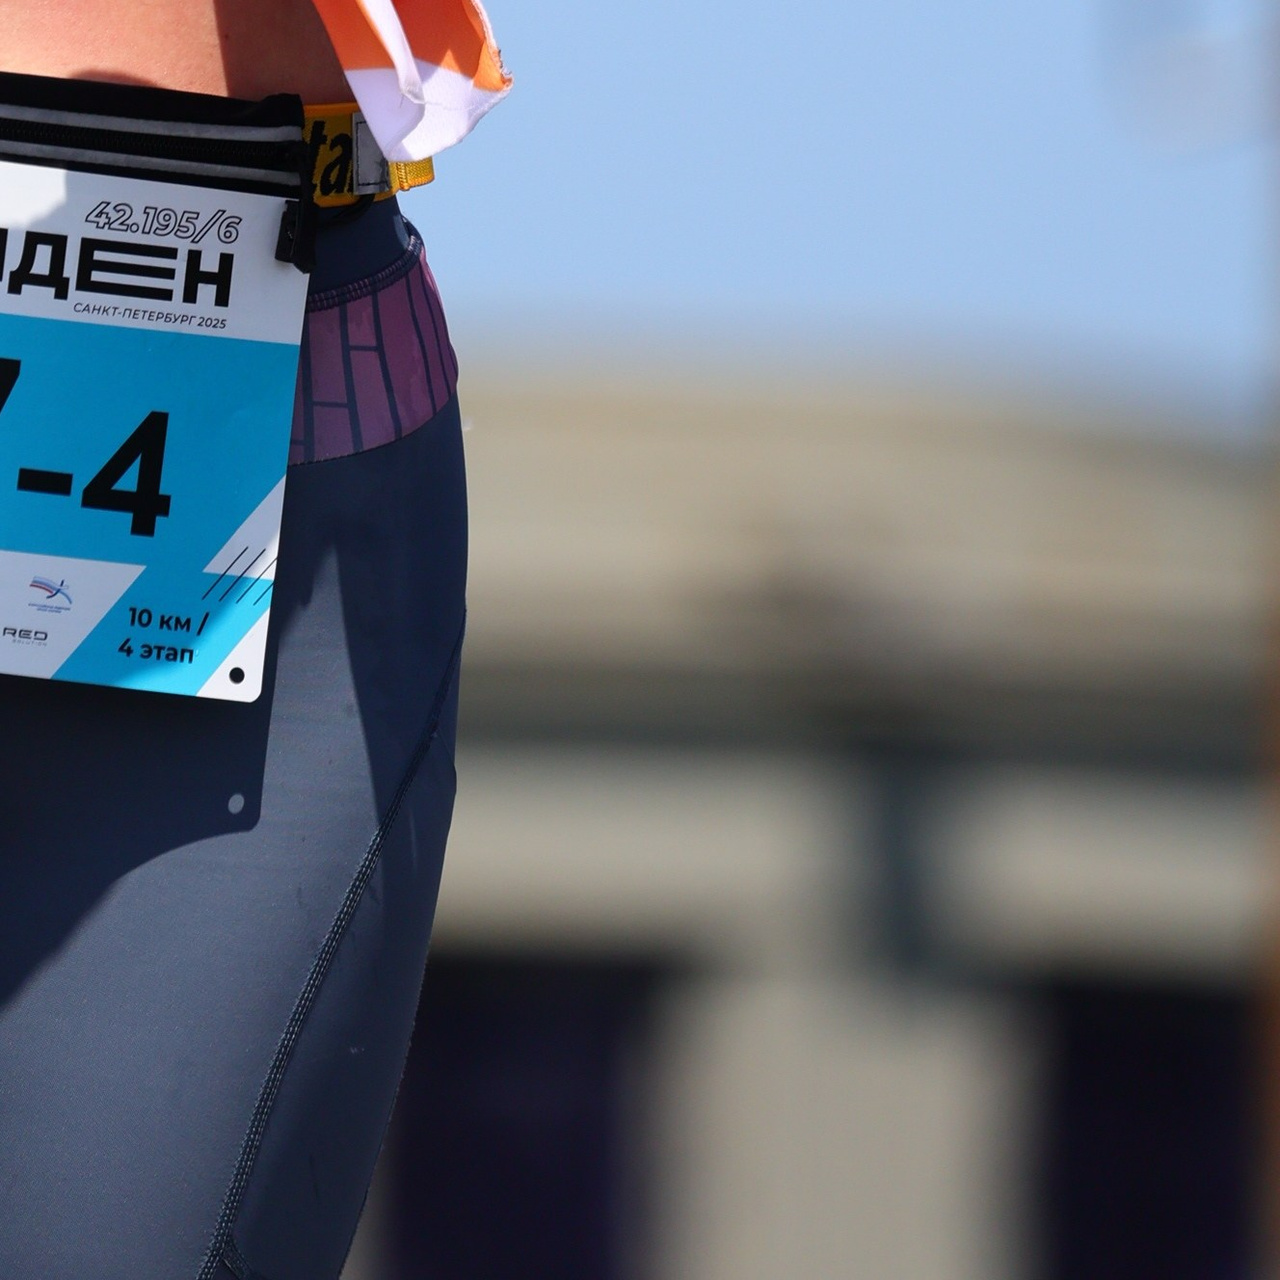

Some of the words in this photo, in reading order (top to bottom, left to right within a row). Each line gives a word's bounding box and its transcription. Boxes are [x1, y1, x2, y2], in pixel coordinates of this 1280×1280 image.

[84, 200, 243, 245] 42.195/6
[73, 302, 197, 326] САНКТ-ПЕТЕРБУРГ
[197, 316, 228, 329] 2025
[129, 606, 153, 628] 10
[159, 614, 192, 633] км
[2, 627, 48, 641] RED
[118, 637, 133, 657] 4
[140, 644, 194, 664] этап
